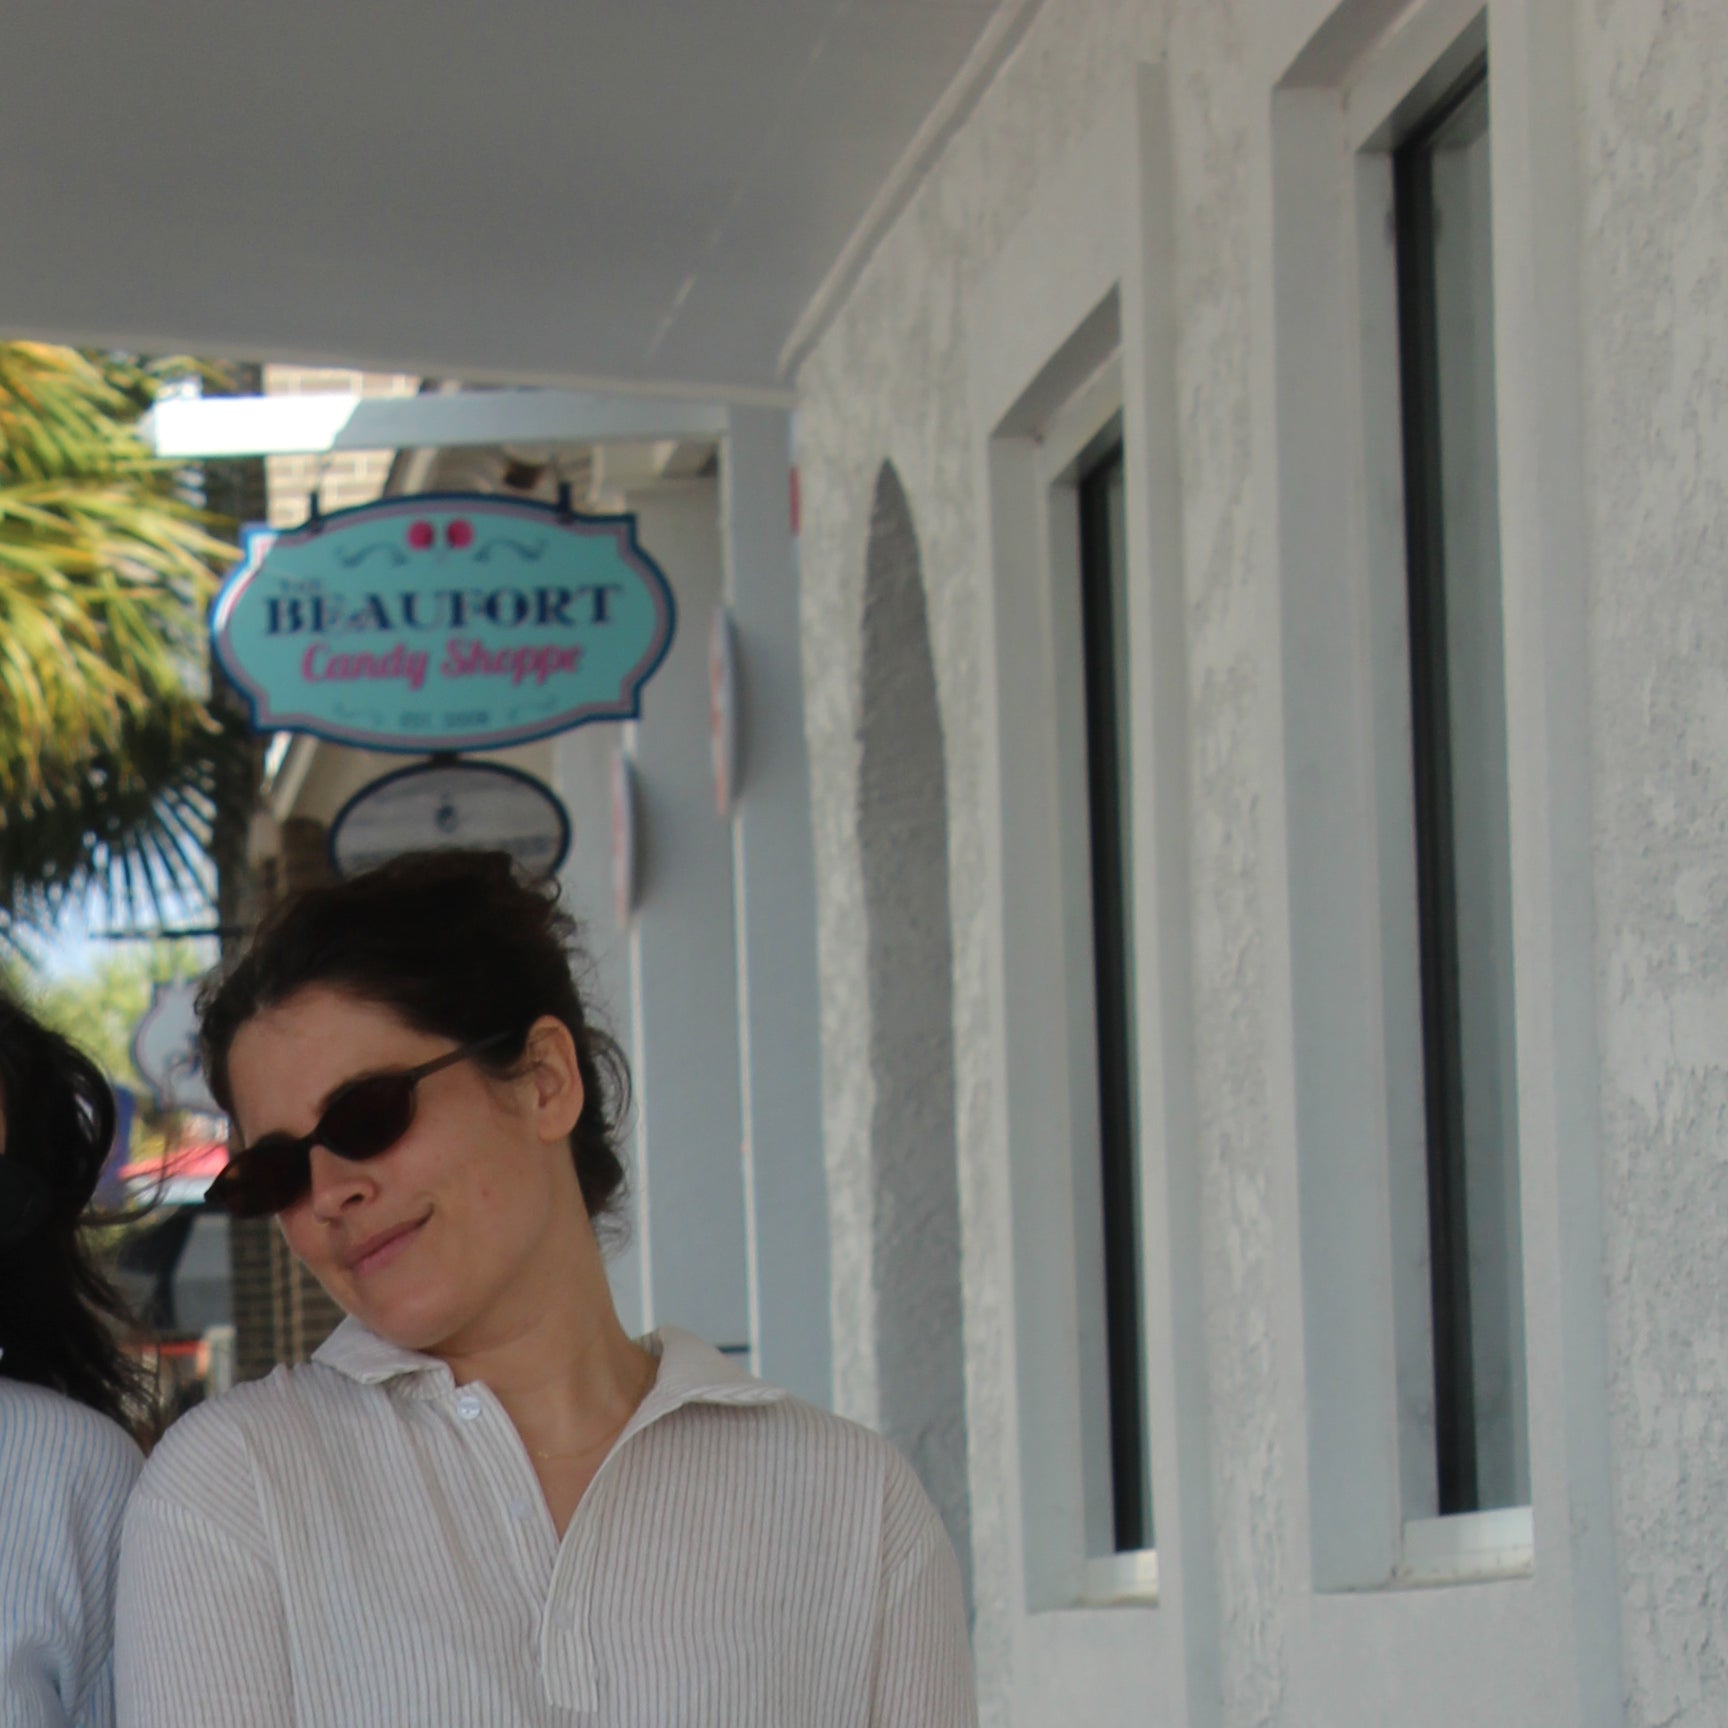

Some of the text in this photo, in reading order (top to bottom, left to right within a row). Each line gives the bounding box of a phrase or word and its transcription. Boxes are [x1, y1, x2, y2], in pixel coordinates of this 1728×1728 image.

[266, 584, 619, 635] BEAUFORT
[301, 638, 582, 690] Candy Shoppe
